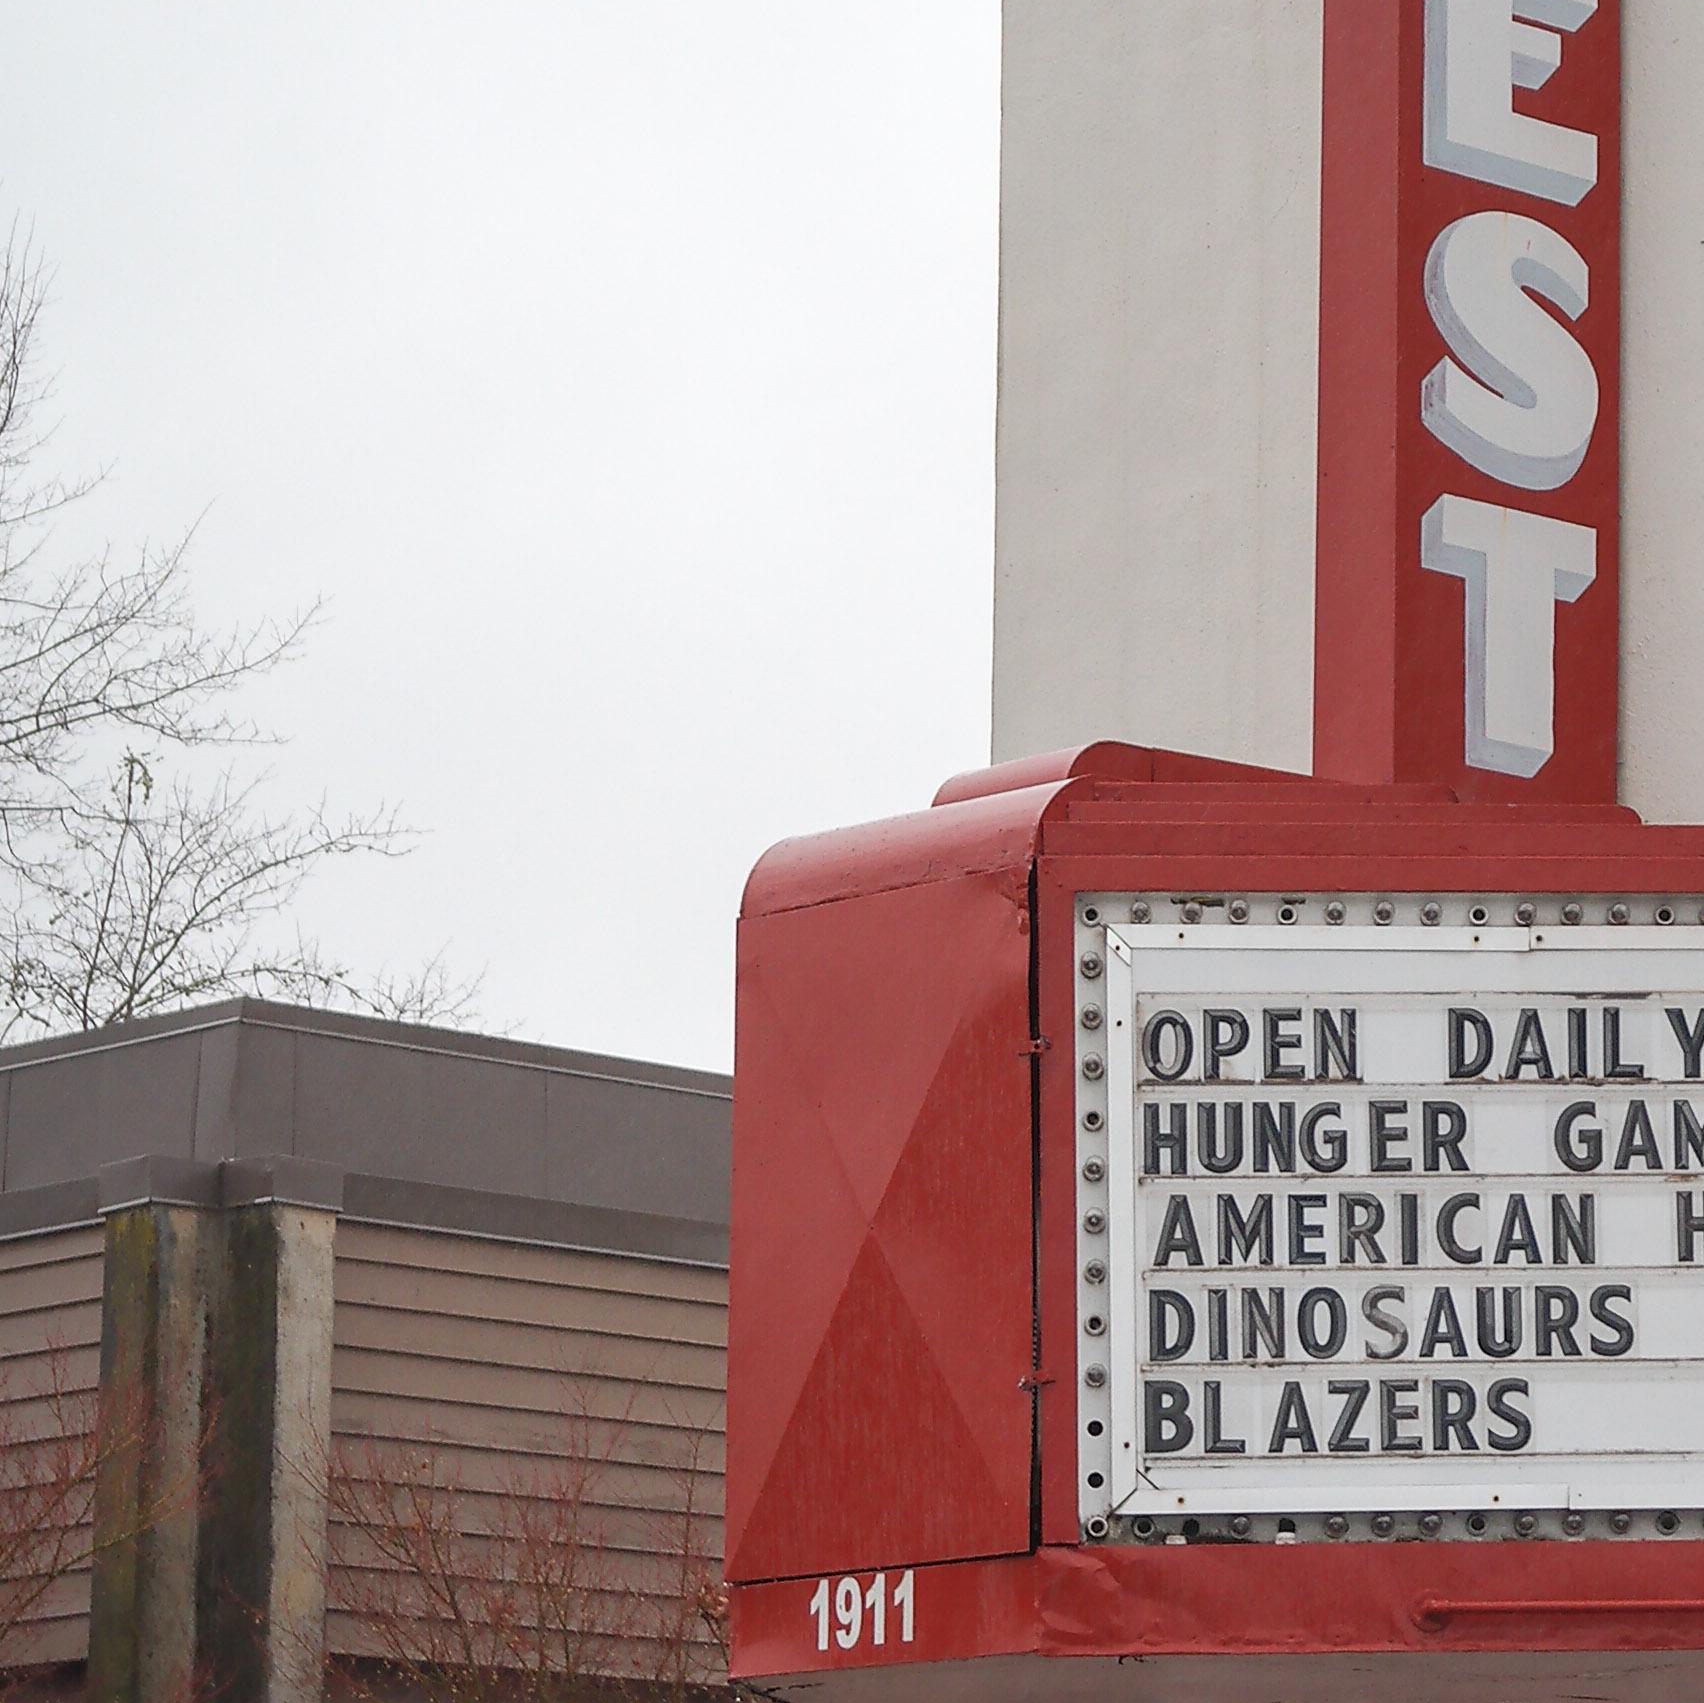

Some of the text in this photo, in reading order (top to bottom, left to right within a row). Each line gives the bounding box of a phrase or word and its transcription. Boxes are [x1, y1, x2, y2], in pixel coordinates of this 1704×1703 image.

[1140, 1007, 1360, 1082] OPEN
[1143, 1100, 1471, 1176] HUNGER
[1153, 1192, 1596, 1267] AMERICAN
[1148, 1284, 1634, 1363] DINOSAURS
[1143, 1377, 1532, 1454] BLAZERS
[809, 1568, 915, 1652] 1911
